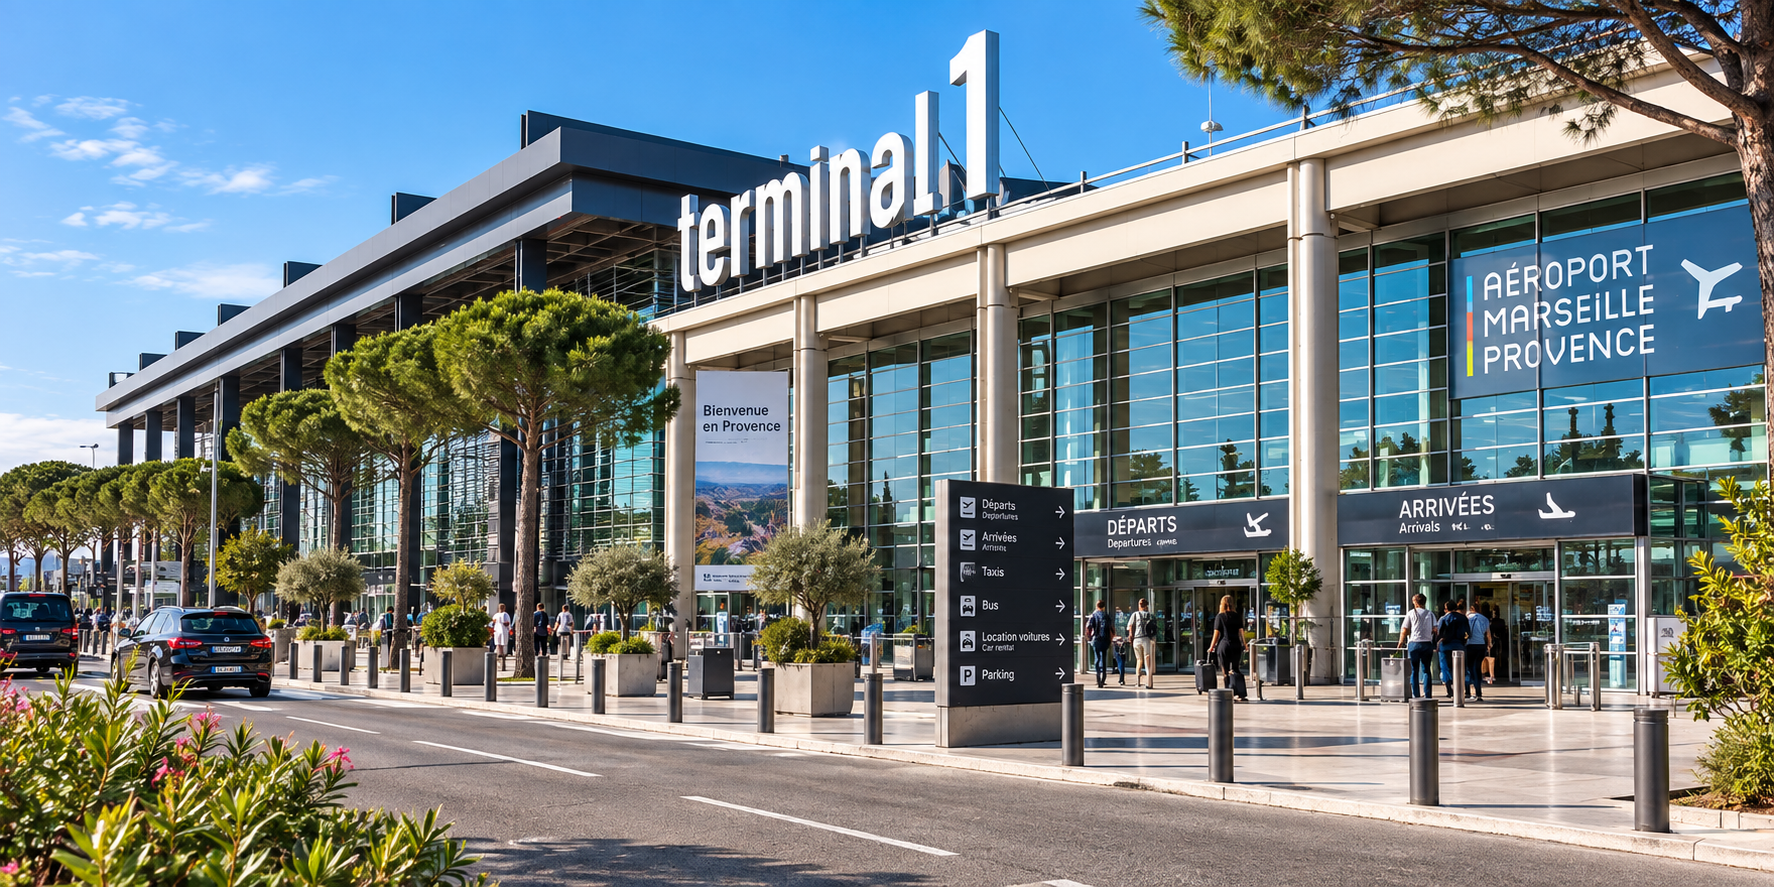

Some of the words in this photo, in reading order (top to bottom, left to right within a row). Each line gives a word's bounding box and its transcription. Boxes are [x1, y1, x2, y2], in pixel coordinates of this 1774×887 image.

[677, 90, 942, 293] terminal
[949, 29, 999, 200] 1
[1483, 244, 1654, 300] AÉROPORT
[1483, 324, 1655, 374] PROVENCE
[703, 405, 769, 416] Bienvenue
[703, 422, 718, 432] en
[722, 420, 781, 432] Provence
[982, 499, 1016, 511] Départs
[1399, 491, 1495, 519] ARRIVÉES
[1107, 515, 1177, 536] DÉPARTS
[1399, 521, 1441, 534] Arrivals
[982, 566, 1005, 577] Taxis
[982, 600, 999, 610] Bus
[982, 632, 1017, 642] Location
[1018, 632, 1050, 642] voitures
[964, 669, 972, 682] P
[982, 669, 1015, 682] Parking
